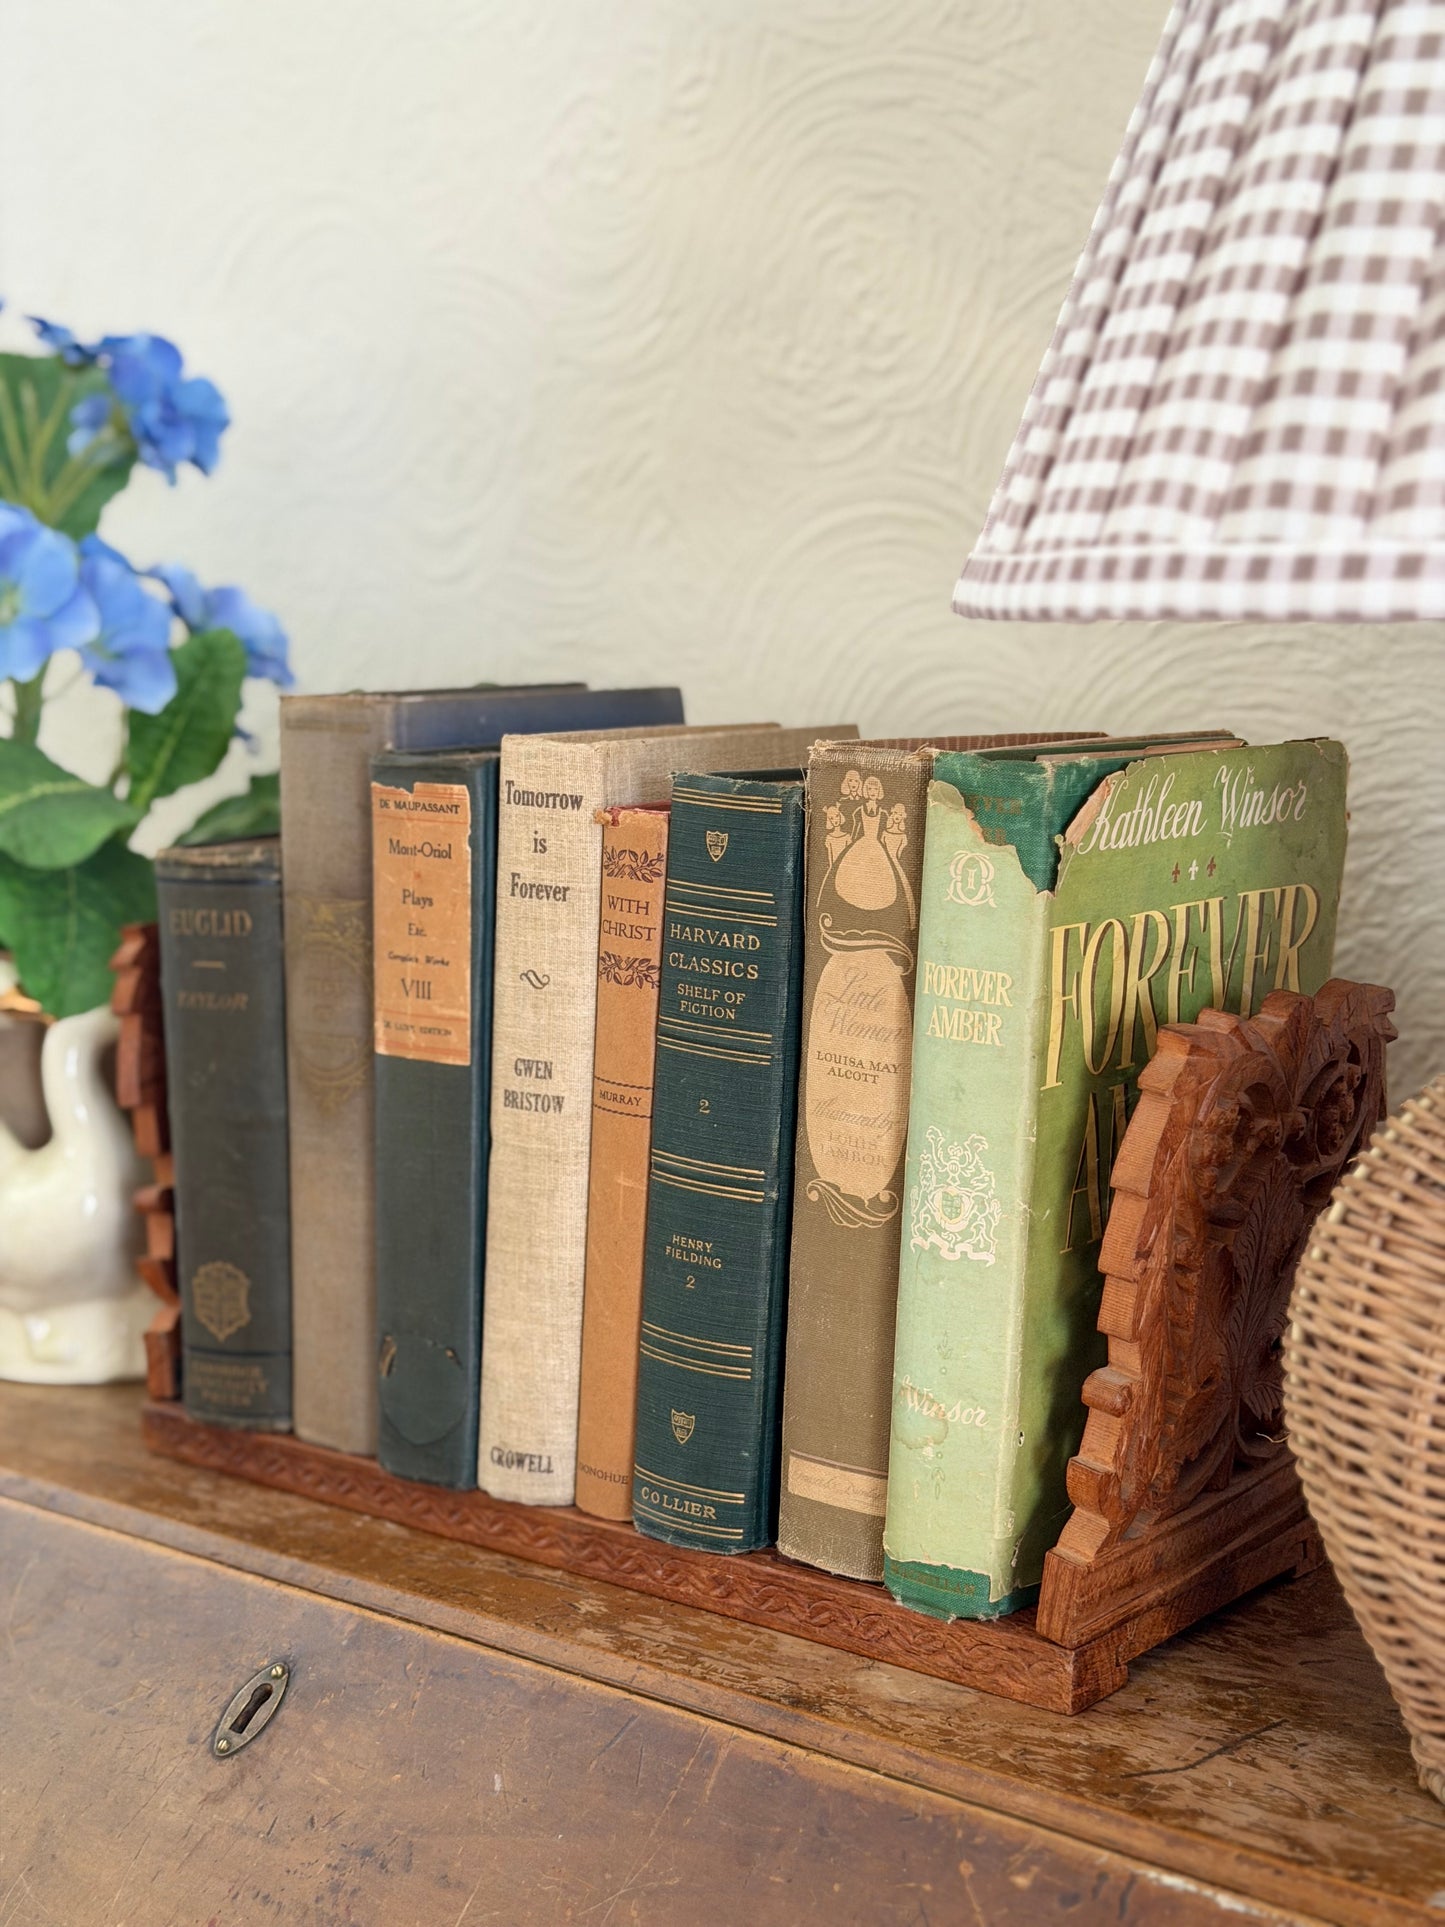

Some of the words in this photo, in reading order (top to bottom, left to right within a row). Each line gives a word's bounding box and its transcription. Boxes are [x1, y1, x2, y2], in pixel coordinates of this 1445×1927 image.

[379, 798, 391, 809] DE
[394, 800, 460, 814] MAUPASSANT
[505, 779, 584, 811] Tomorrow
[1076, 770, 1208, 854] Kathleen
[1214, 765, 1308, 849] Winsor
[388, 838, 453, 860] Mont-Oriol
[532, 830, 548, 854] is
[402, 888, 434, 909] Plays
[510, 872, 571, 902] Forever
[607, 894, 650, 916] WITH
[169, 908, 253, 937] EUCLID
[602, 919, 657, 942] CHRIST
[669, 923, 761, 951] HARVARD
[668, 952, 760, 980] CLASSICS
[401, 977, 432, 1000] VIII
[677, 983, 721, 1001] SHELF
[724, 991, 746, 1005] OF
[922, 960, 1014, 1007] FOREVER
[1040, 883, 1319, 1091] FOREVER
[680, 1001, 736, 1020] FICTION
[926, 1005, 1004, 1047] AMBER
[514, 1057, 553, 1080] GWEN
[817, 1051, 866, 1071] LOUISA
[869, 1060, 902, 1075] MAY
[827, 1066, 880, 1085] ALCOTT
[503, 1089, 565, 1115] BRISTOW
[600, 1089, 642, 1107] MURRAY
[699, 1099, 711, 1115] 2
[672, 1233, 713, 1253] HENRY
[665, 1246, 723, 1270] FIELDING
[685, 1275, 696, 1290] 2
[900, 1375, 990, 1427] Winsor
[490, 1446, 554, 1475] CROWELL
[641, 1486, 718, 1520] COLLIER
